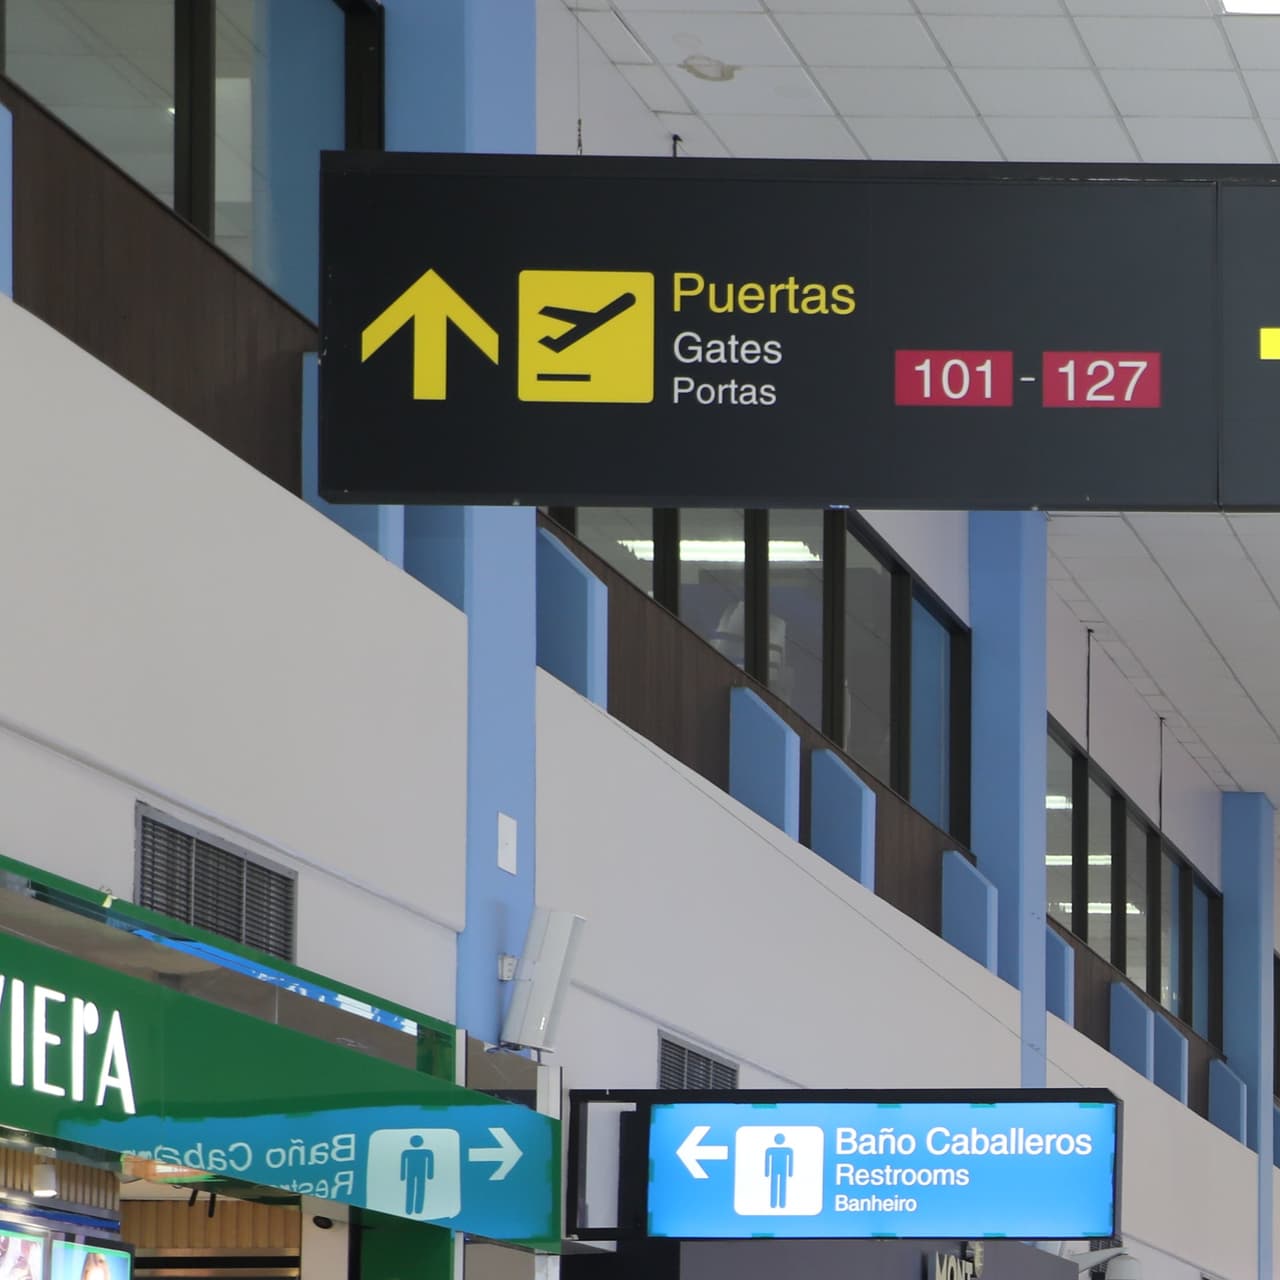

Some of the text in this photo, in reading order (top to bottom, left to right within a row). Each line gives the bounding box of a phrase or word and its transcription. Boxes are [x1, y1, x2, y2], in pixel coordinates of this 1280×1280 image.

[672, 272, 857, 317] Puertas
[673, 331, 783, 366] Gates
[673, 376, 778, 408] Portas
[913, 358, 995, 400] 101
[1057, 360, 1148, 402] 127
[835, 1127, 1093, 1156] Baño Caballeros
[835, 1163, 970, 1187] Restrooms
[834, 1194, 918, 1213] Banheiro
